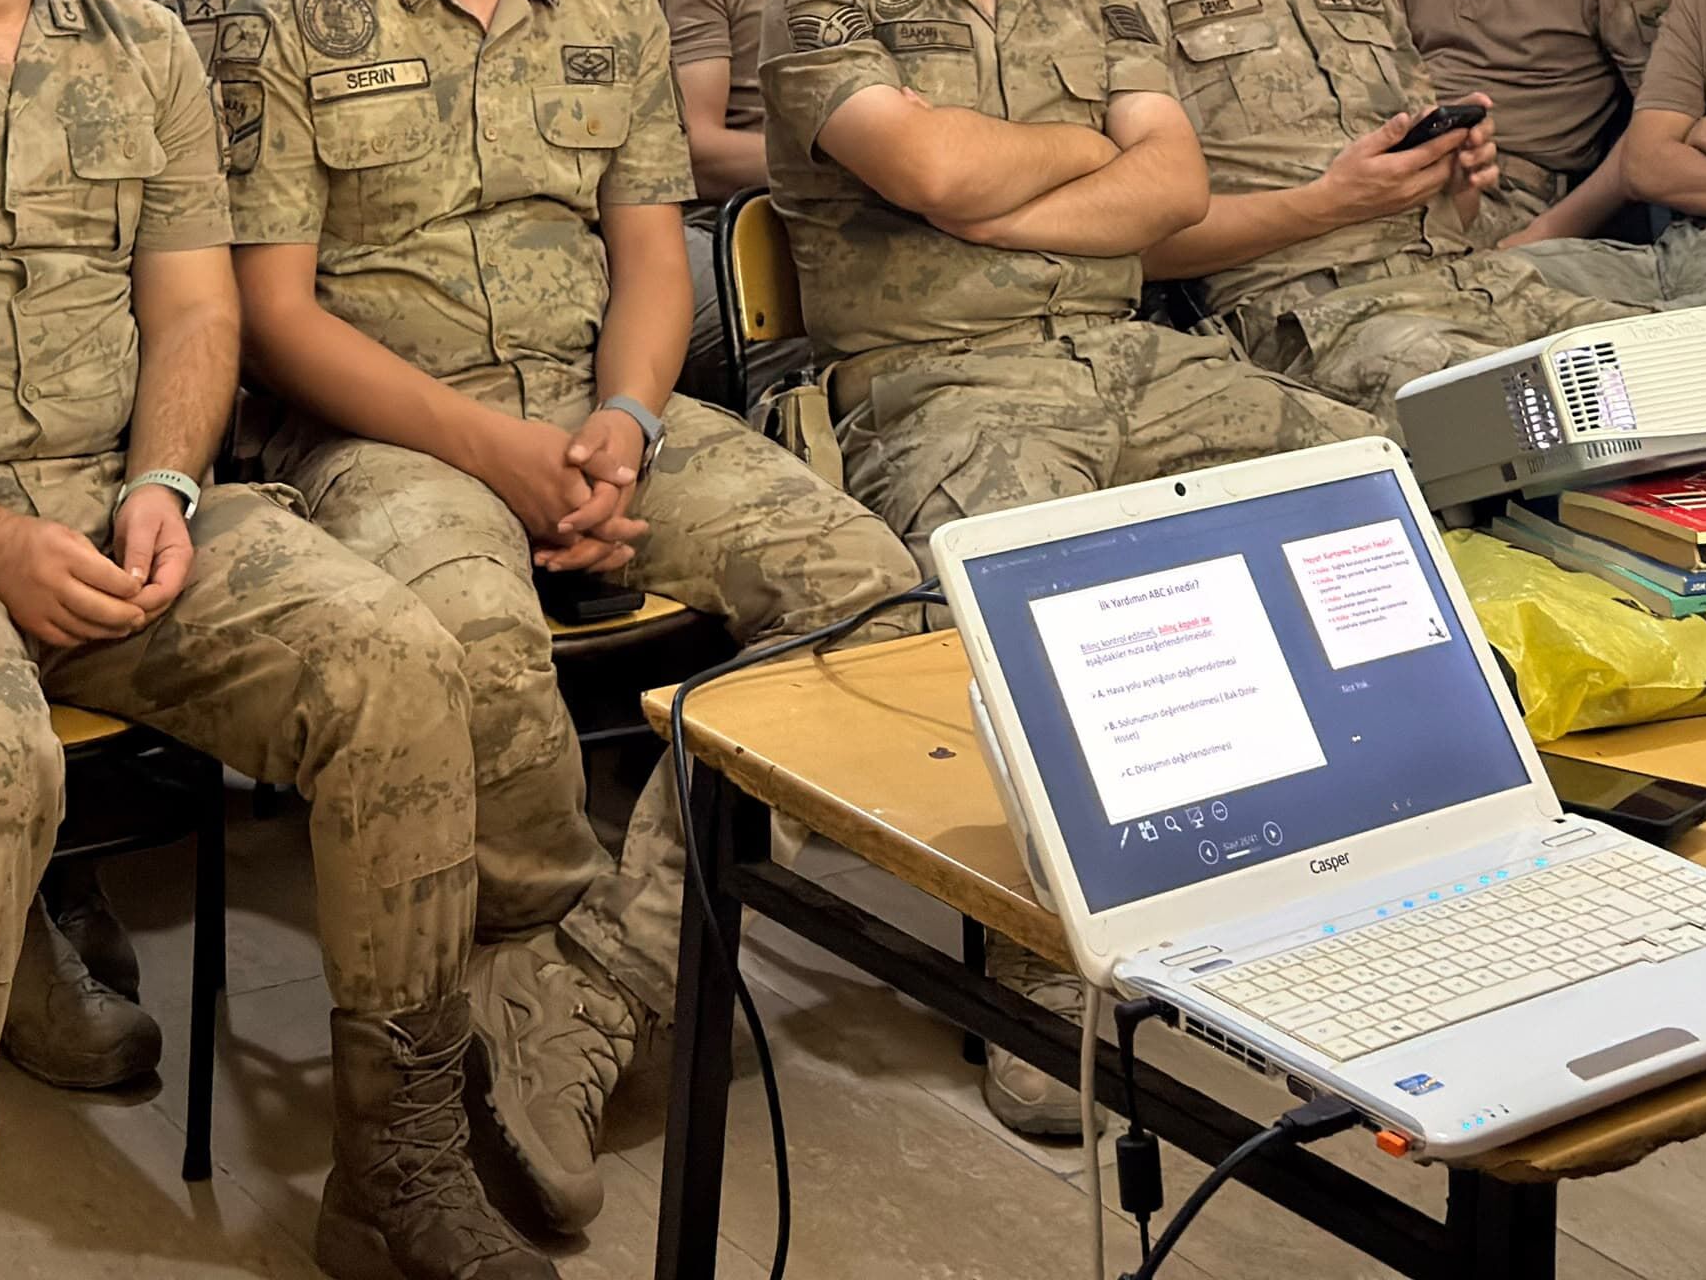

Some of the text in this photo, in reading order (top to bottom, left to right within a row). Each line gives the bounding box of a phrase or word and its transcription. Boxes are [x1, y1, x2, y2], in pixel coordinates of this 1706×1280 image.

[1149, 588, 1166, 599] ABC
[1174, 580, 1200, 594] nedir?
[1309, 852, 1350, 874] Casper
